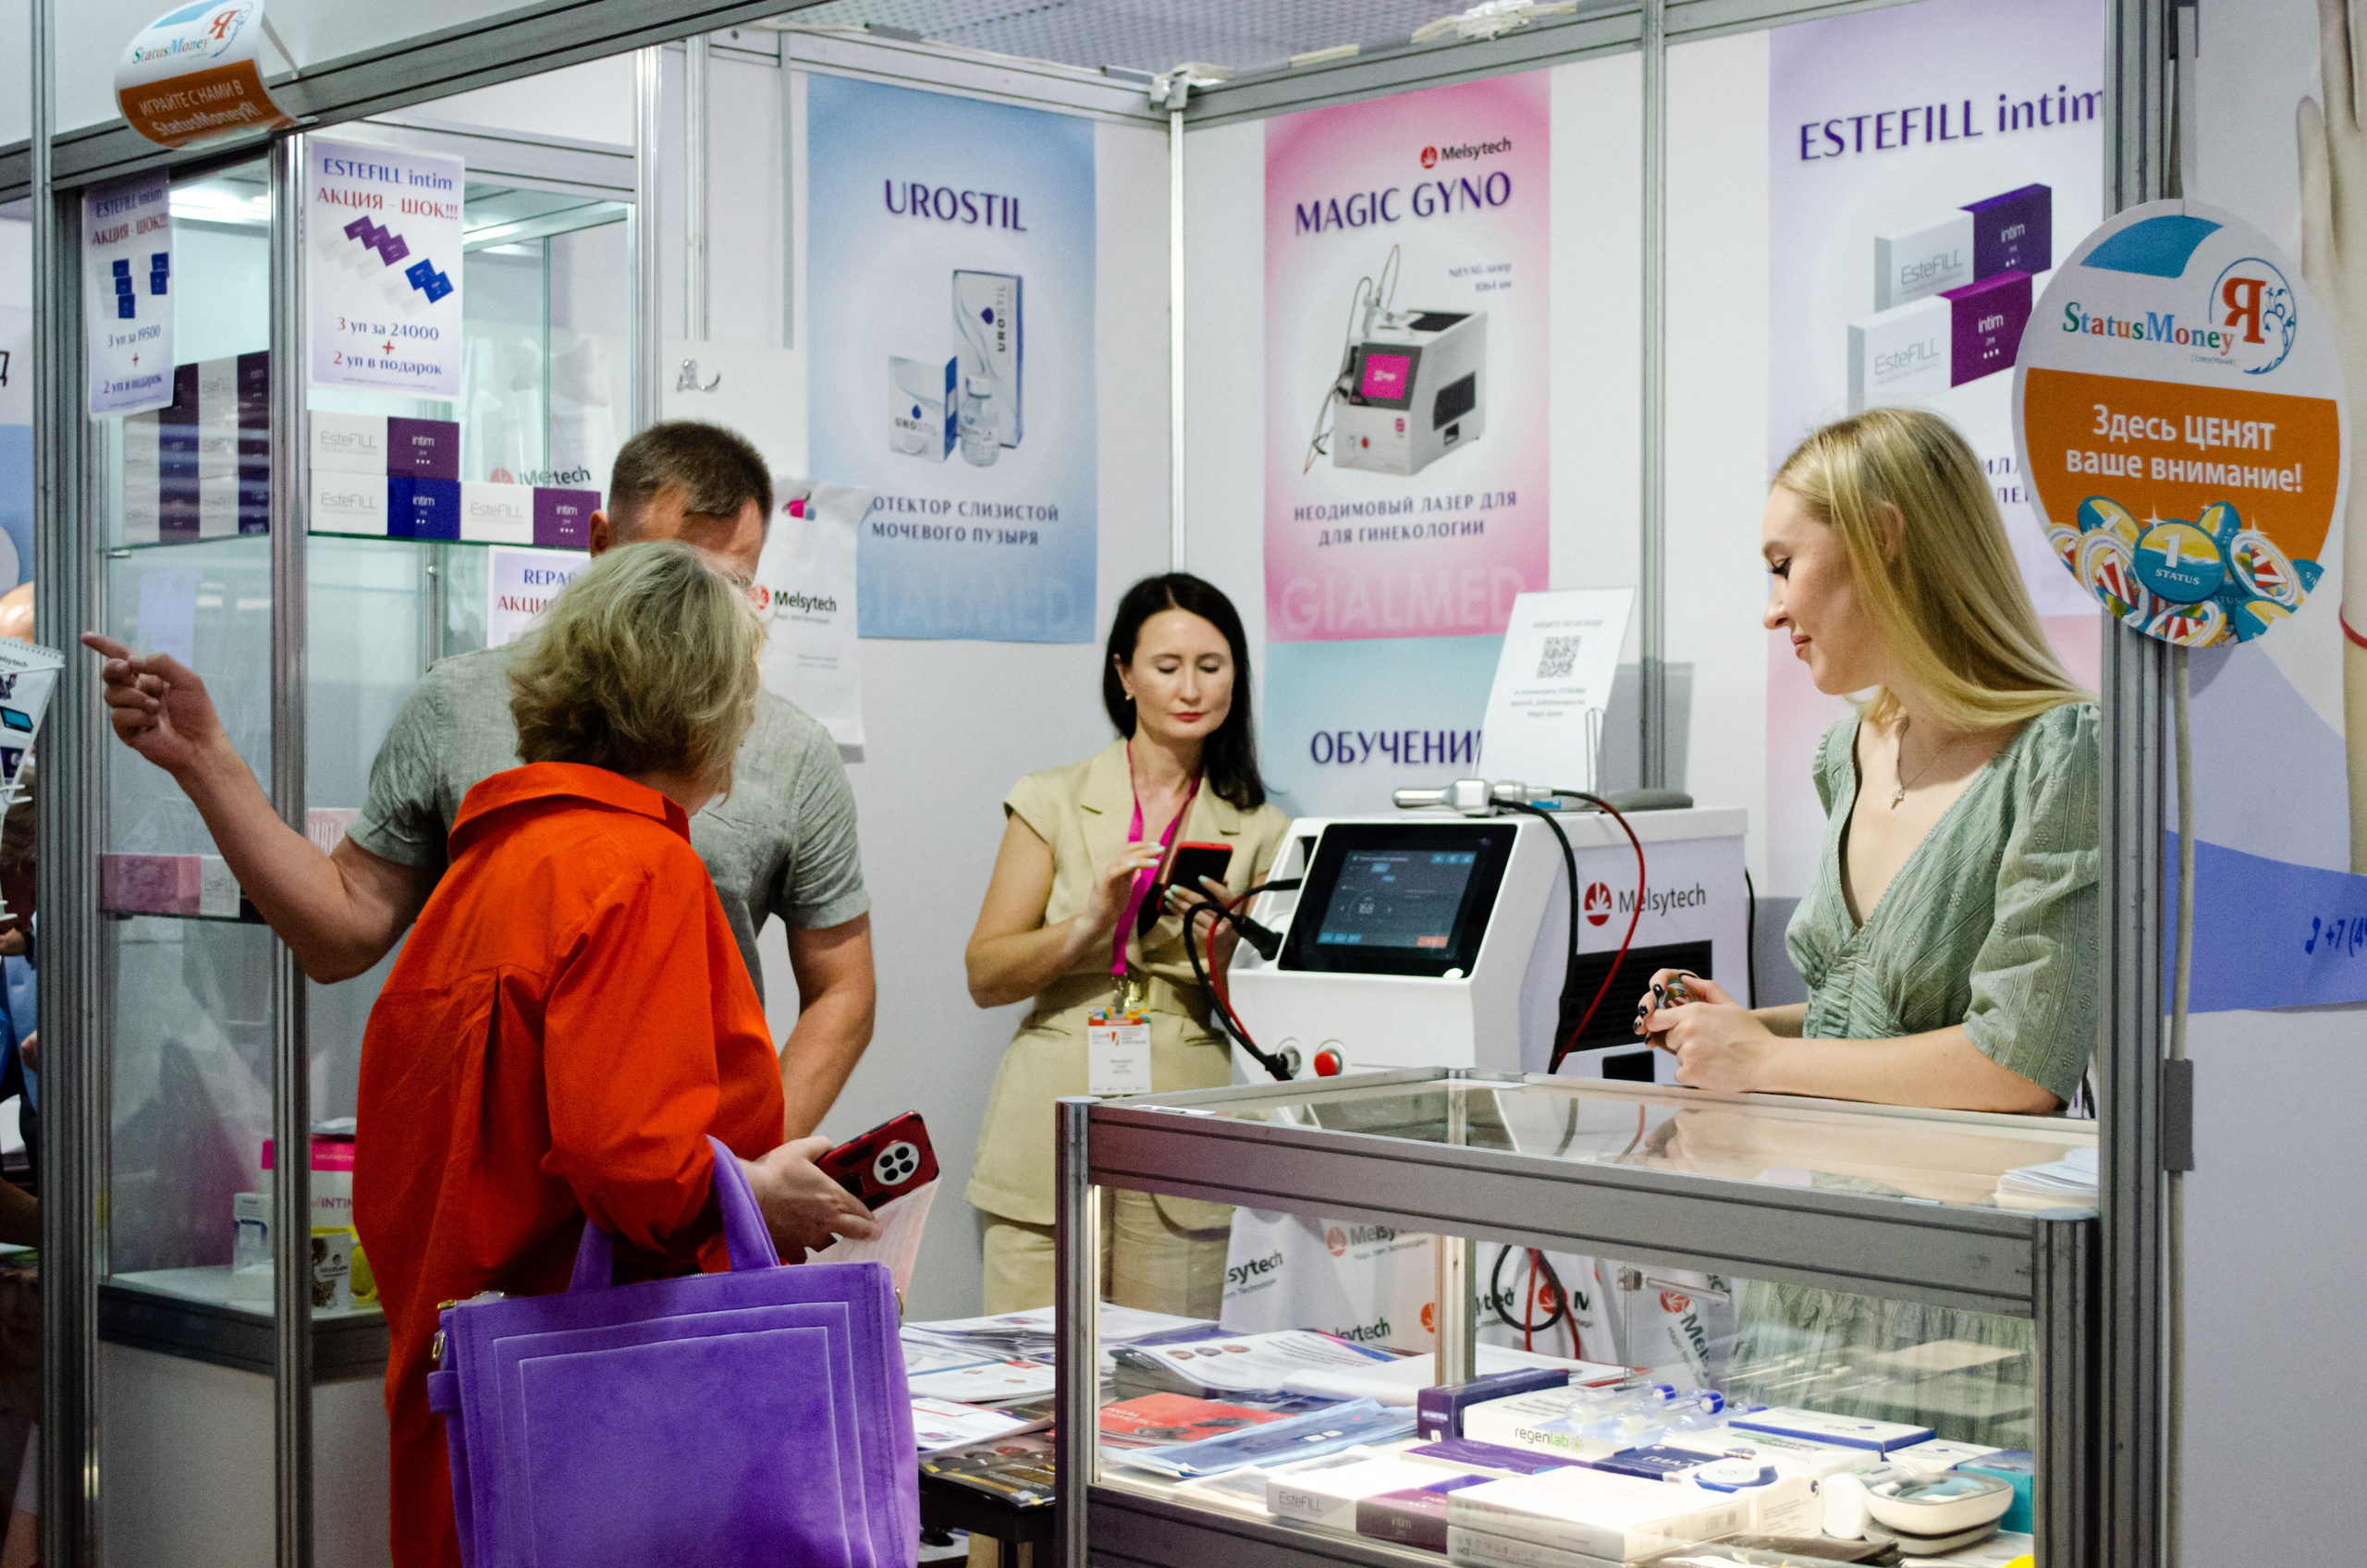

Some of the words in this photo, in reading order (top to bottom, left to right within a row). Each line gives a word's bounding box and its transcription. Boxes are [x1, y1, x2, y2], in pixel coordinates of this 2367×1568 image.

[140, 92, 189, 116] ИГРАЙТЕ
[188, 92, 199, 105] С
[198, 83, 233, 104] НАМИ
[234, 80, 244, 96] В
[1799, 98, 1983, 162] ESTEFILL
[1997, 84, 2103, 133] intim
[1441, 137, 1512, 162] Melsytech
[324, 157, 404, 185] ESTEFILL
[409, 169, 452, 190] intim
[95, 195, 139, 218] ESTEFILL
[139, 188, 163, 208] intim
[317, 187, 384, 211] АКЦИЯ
[400, 197, 459, 220] ШОК!!!
[885, 178, 1027, 233] UROSTIL
[1295, 188, 1401, 236] MAGIC
[1412, 171, 1511, 217] GYNO
[92, 224, 129, 246] АКЦИЯ
[136, 212, 168, 236] ШОК!!!
[2001, 223, 2025, 243] intim
[1901, 249, 1962, 286] EsteFILL
[337, 316, 346, 331] 3
[350, 320, 367, 335] уп
[372, 325, 386, 336] за
[390, 324, 439, 341] 24000
[997, 285, 1008, 352] UROSTIL
[1978, 314, 2004, 334] intim
[108, 335, 114, 348] 3
[116, 335, 127, 348] уп
[129, 332, 136, 343] за
[138, 324, 161, 341] 19500
[334, 350, 342, 365] 2
[347, 355, 363, 370] уп
[368, 358, 375, 368] в
[380, 361, 442, 376] подарок
[1874, 337, 1940, 376] EsteFILL
[104, 380, 110, 394] 2
[112, 380, 123, 393] уп
[125, 380, 130, 390] в
[131, 374, 162, 389] подарок
[320, 431, 377, 449] EsteFILL
[2093, 404, 2177, 443] Здесь
[2184, 414, 2275, 451] ЦЕНЯТ
[411, 435, 435, 447] intim
[2067, 448, 2142, 478] ваше
[2151, 458, 2303, 493] внимание!
[321, 492, 377, 509] EsteFILL
[412, 495, 435, 507] intim
[470, 502, 524, 519] EsteFILL
[557, 505, 577, 516] intim
[958, 500, 1059, 521] СЛИЗИСТОЙ
[1294, 496, 1413, 521] НЕОДИМОВЫЙ
[1421, 494, 1474, 513] ЛАЗЕР
[1480, 490, 1516, 509] ДЛЯ
[872, 522, 966, 542] МОЧЕВОГО
[973, 527, 1038, 545] ПУЗЫРЯ
[1318, 528, 1352, 548] ДЛЯ
[1359, 520, 1484, 543] ГИНЕКОЛОГИИ
[2164, 533, 2180, 569] 1
[2155, 568, 2200, 585] STATUS
[774, 591, 837, 613] Melsytech
[1281, 564, 1525, 635] GIALMED
[1619, 882, 1706, 917] Melsytech
[1515, 1427, 1569, 1449] regenlab
[1279, 1491, 1323, 1512] EsteFILL
[1392, 1516, 1412, 1529] intim
